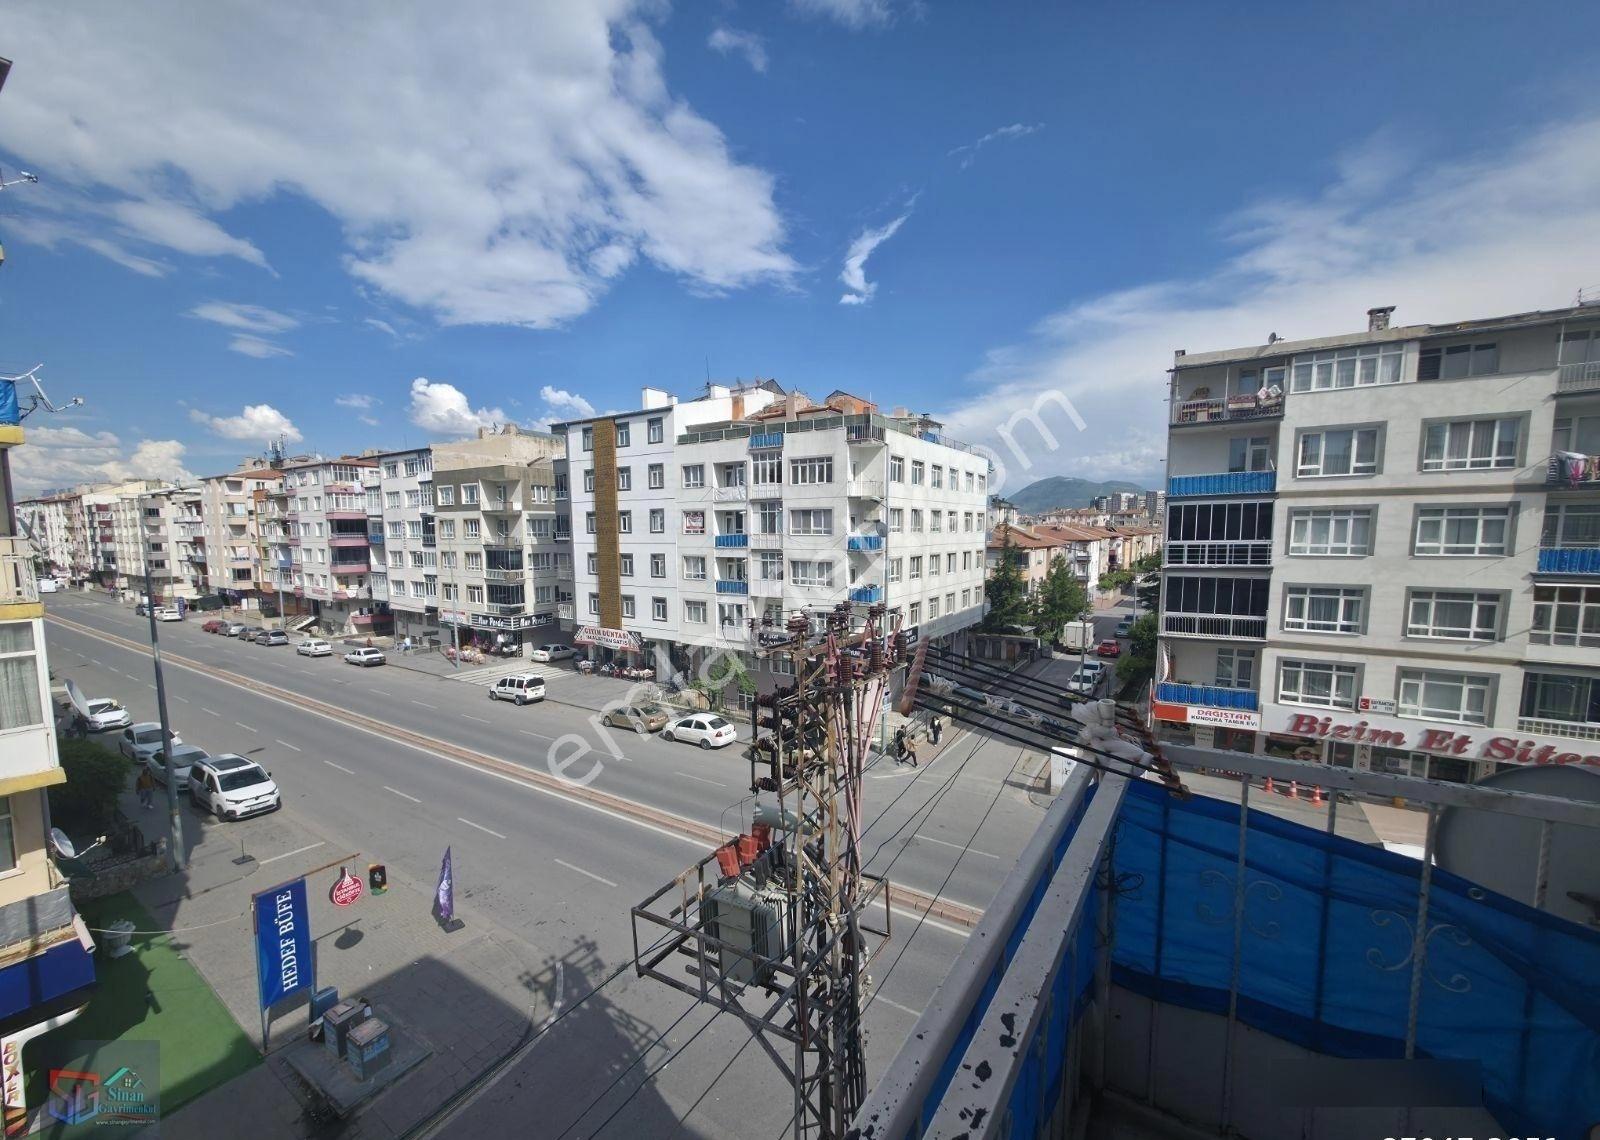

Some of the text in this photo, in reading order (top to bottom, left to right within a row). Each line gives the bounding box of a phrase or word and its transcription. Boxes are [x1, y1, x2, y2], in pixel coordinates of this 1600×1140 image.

[1191, 715, 1223, 723] KUNDURA
[1289, 712, 1407, 746] Bizim
[1417, 728, 1474, 755] Et
[274, 890, 299, 992] HEDEF BÜFE
[3, 1041, 21, 1105] BOXER
